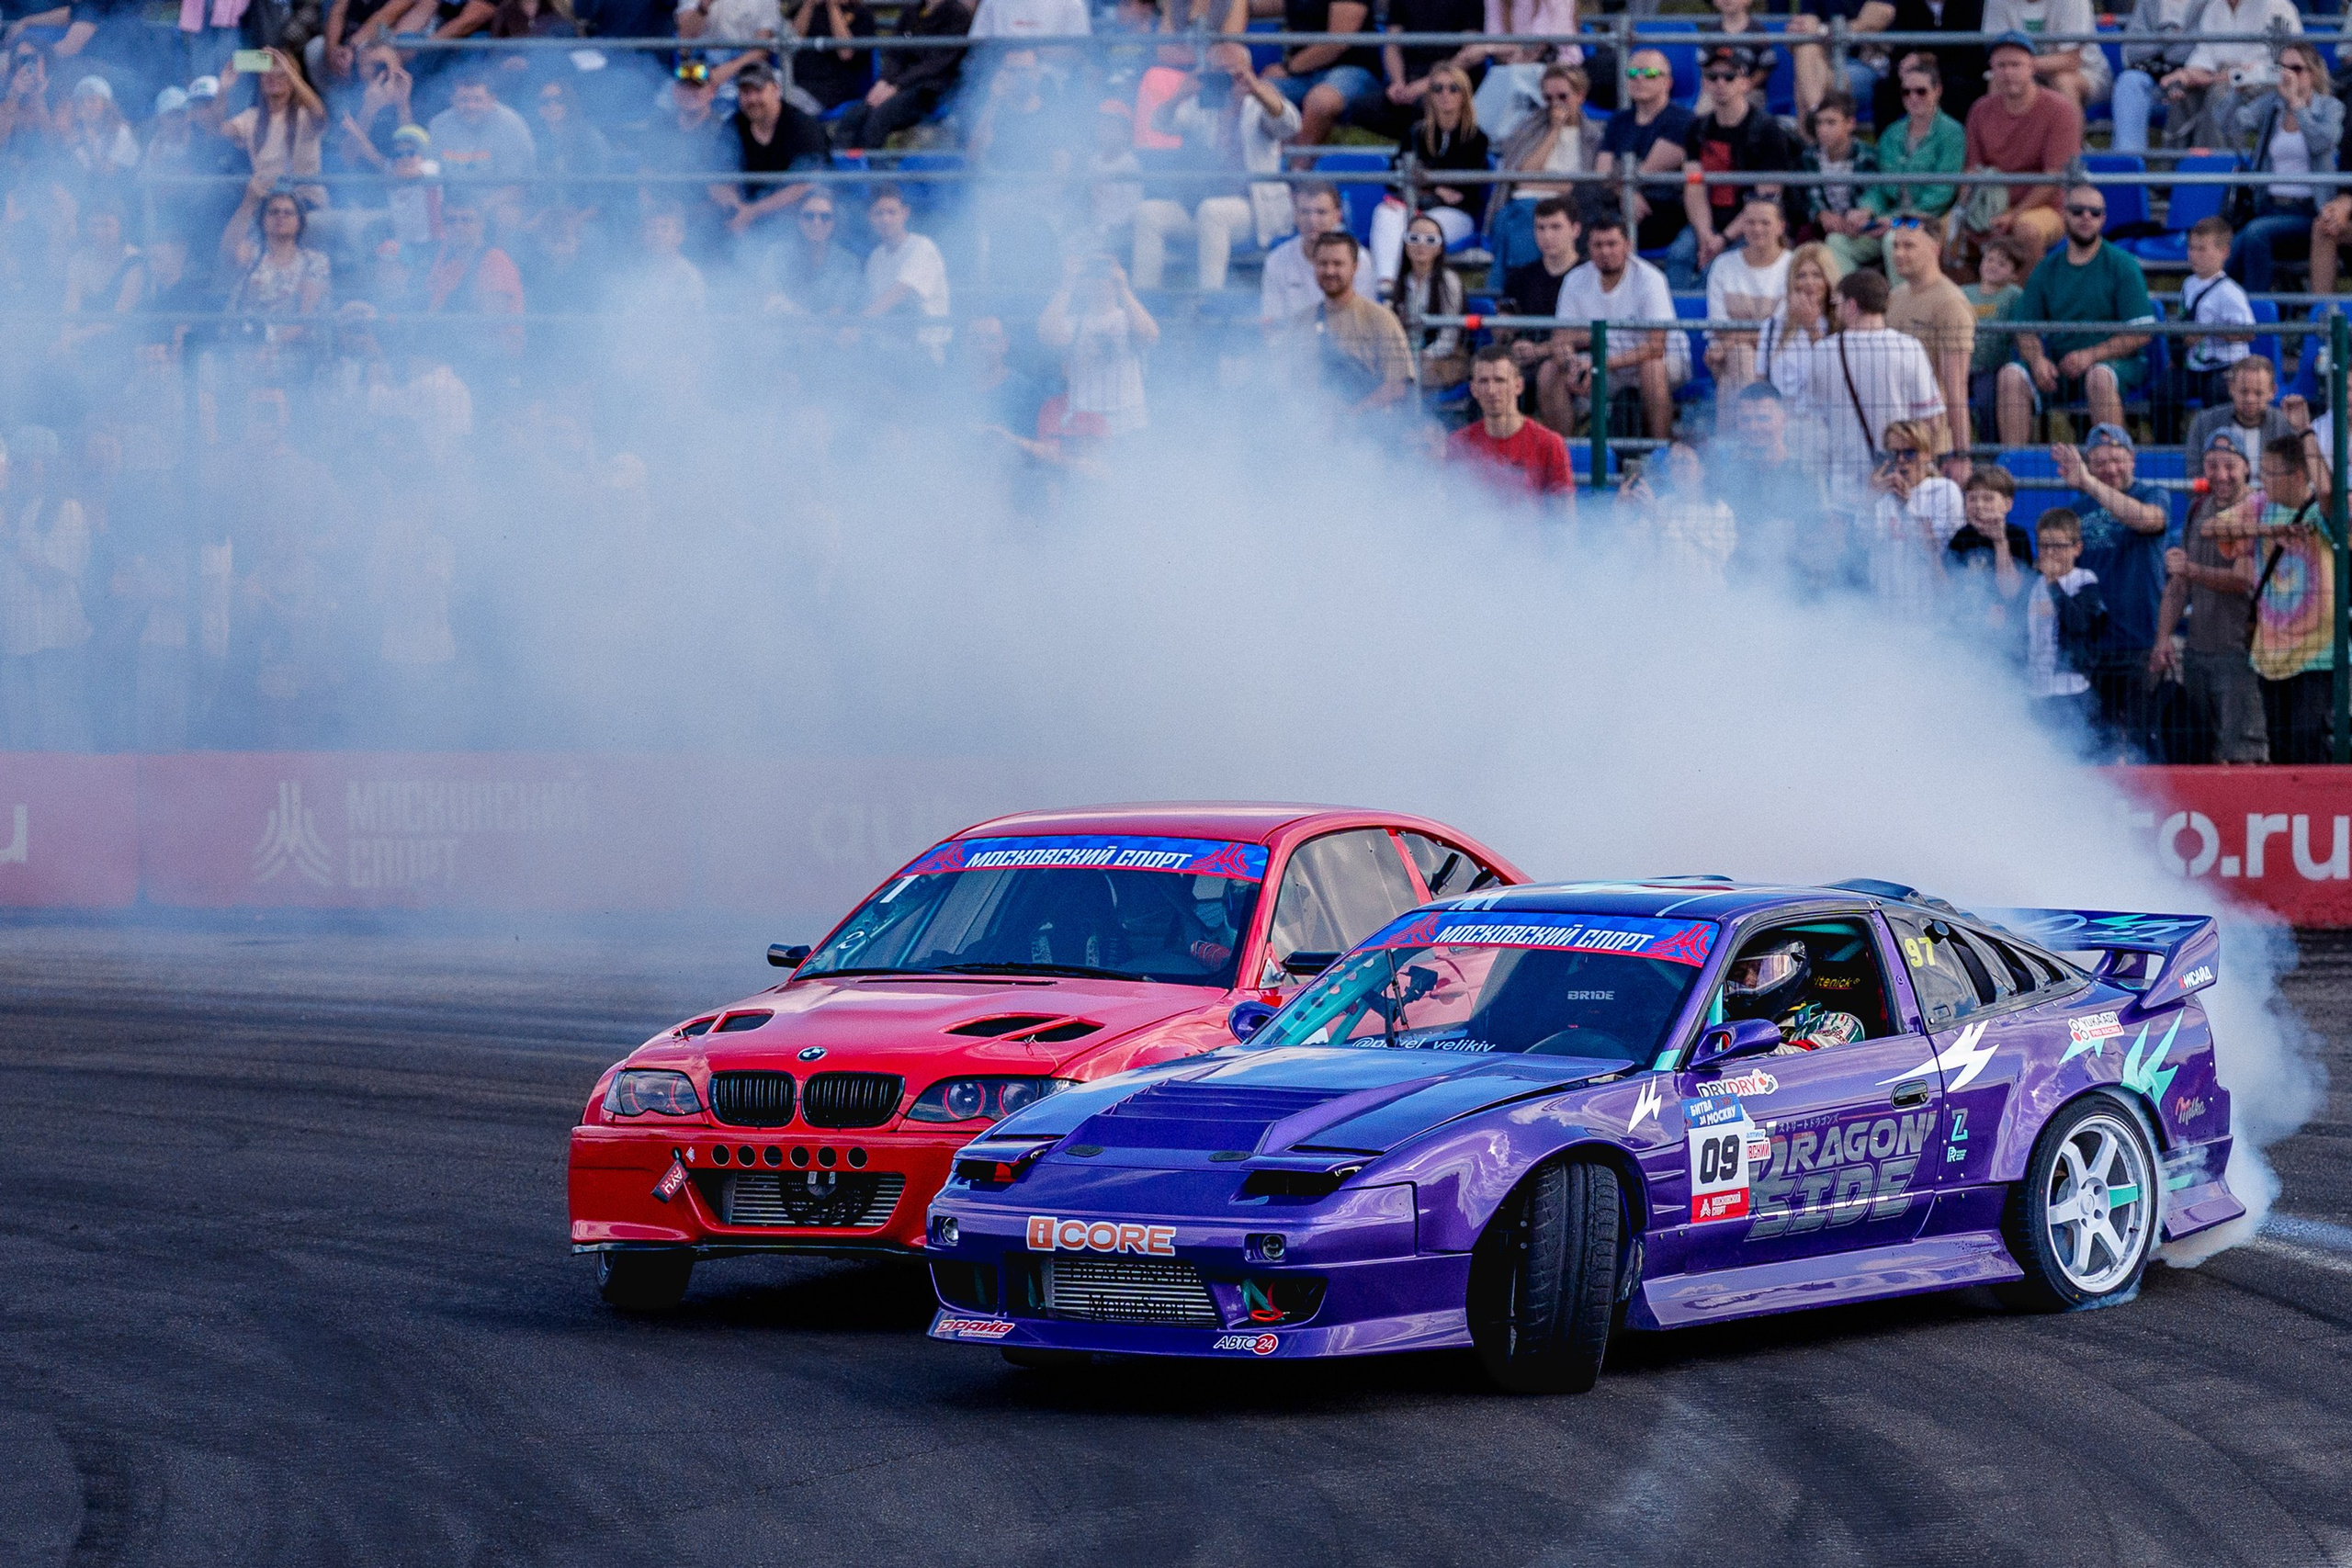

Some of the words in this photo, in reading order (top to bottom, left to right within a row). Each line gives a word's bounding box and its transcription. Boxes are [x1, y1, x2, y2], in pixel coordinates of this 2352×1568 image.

[965, 845, 1117, 868] МОСКОВСКИЙ
[1114, 850, 1193, 869] СПОРТ
[1432, 924, 1581, 946] МОСКОВСКИЙ
[1573, 929, 1655, 953] СПОРТ
[1905, 937, 1936, 968] 97
[1566, 990, 1615, 1000] BRIDE
[1690, 1099, 1714, 1117] БИТВА
[1706, 1104, 1736, 1126] МОСКВУ
[1699, 1134, 1740, 1185] 09
[1744, 1154, 1921, 1242] SIDE
